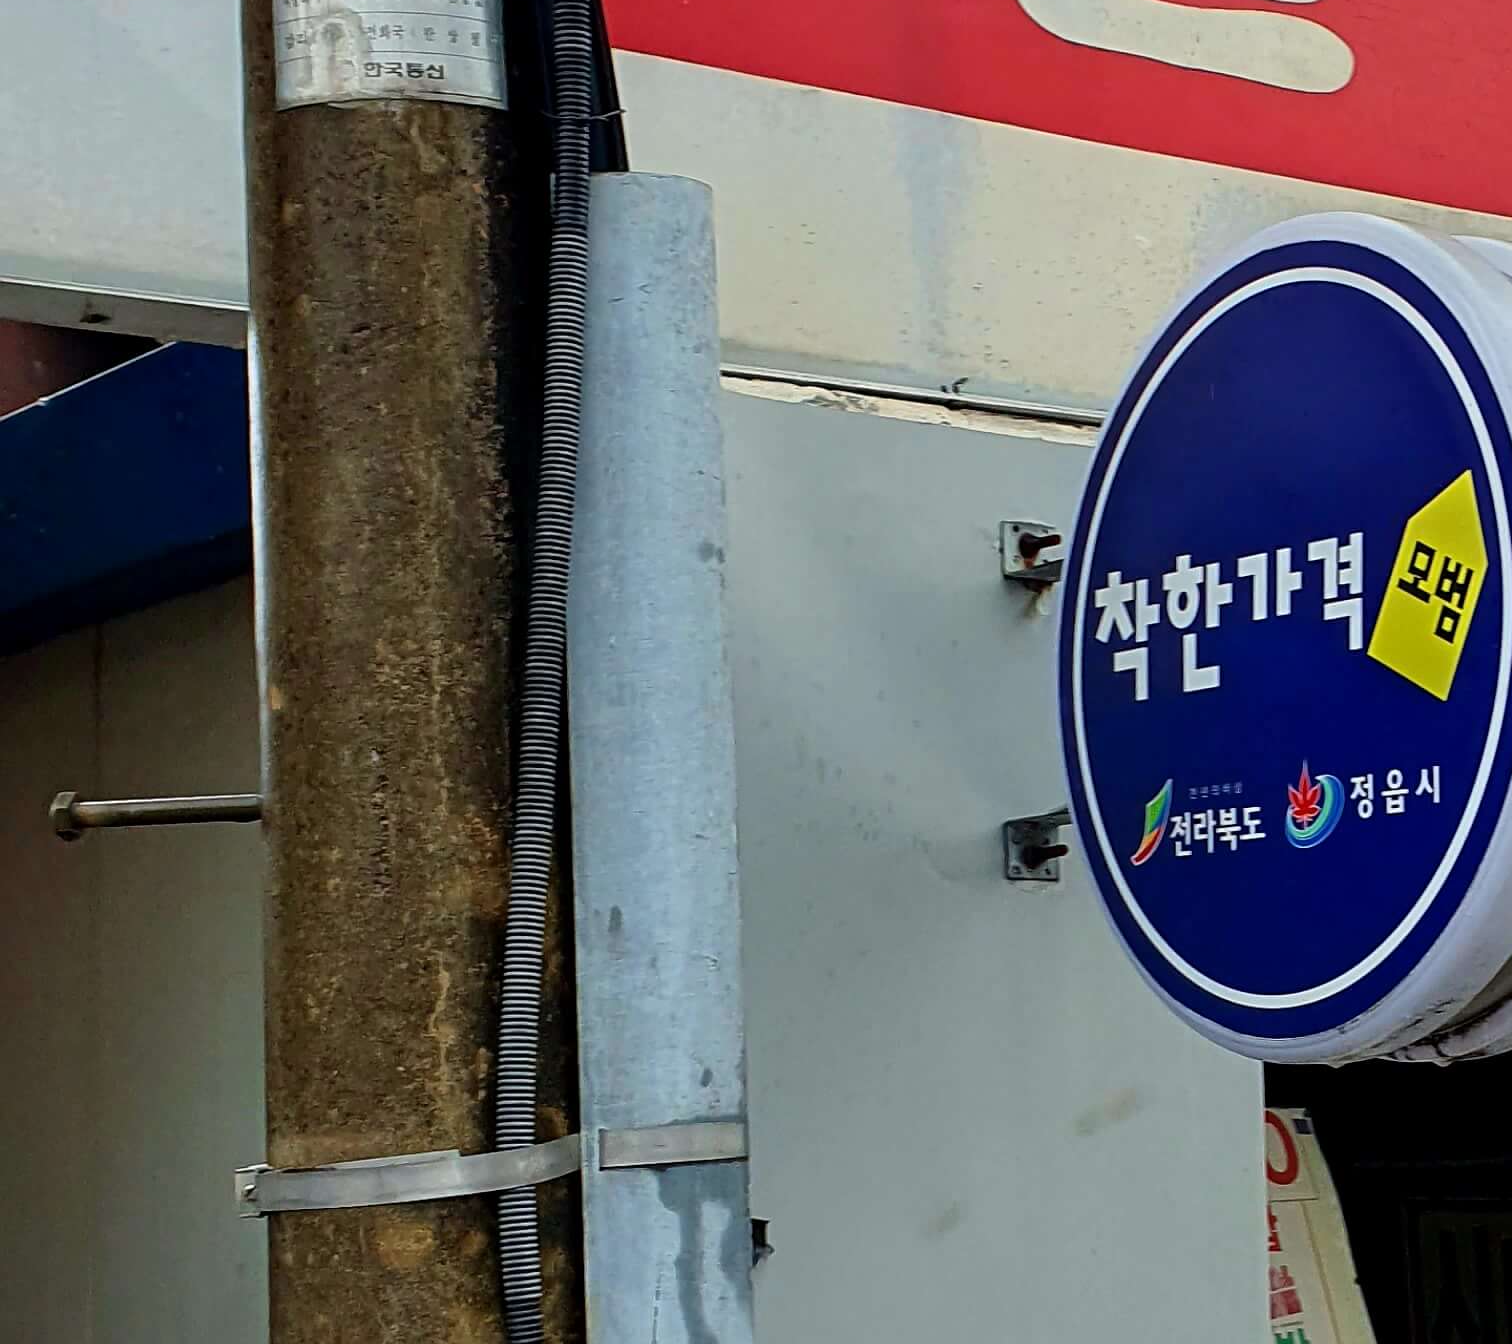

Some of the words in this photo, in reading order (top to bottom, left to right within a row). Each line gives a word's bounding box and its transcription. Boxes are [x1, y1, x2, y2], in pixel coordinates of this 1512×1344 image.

[363, 61, 446, 80] 한국통신
[1094, 531, 1364, 701] 착한가격
[1396, 540, 1474, 644] 모범
[1349, 764, 1442, 819] 정읍시
[1169, 805, 1266, 857] 전라북도
